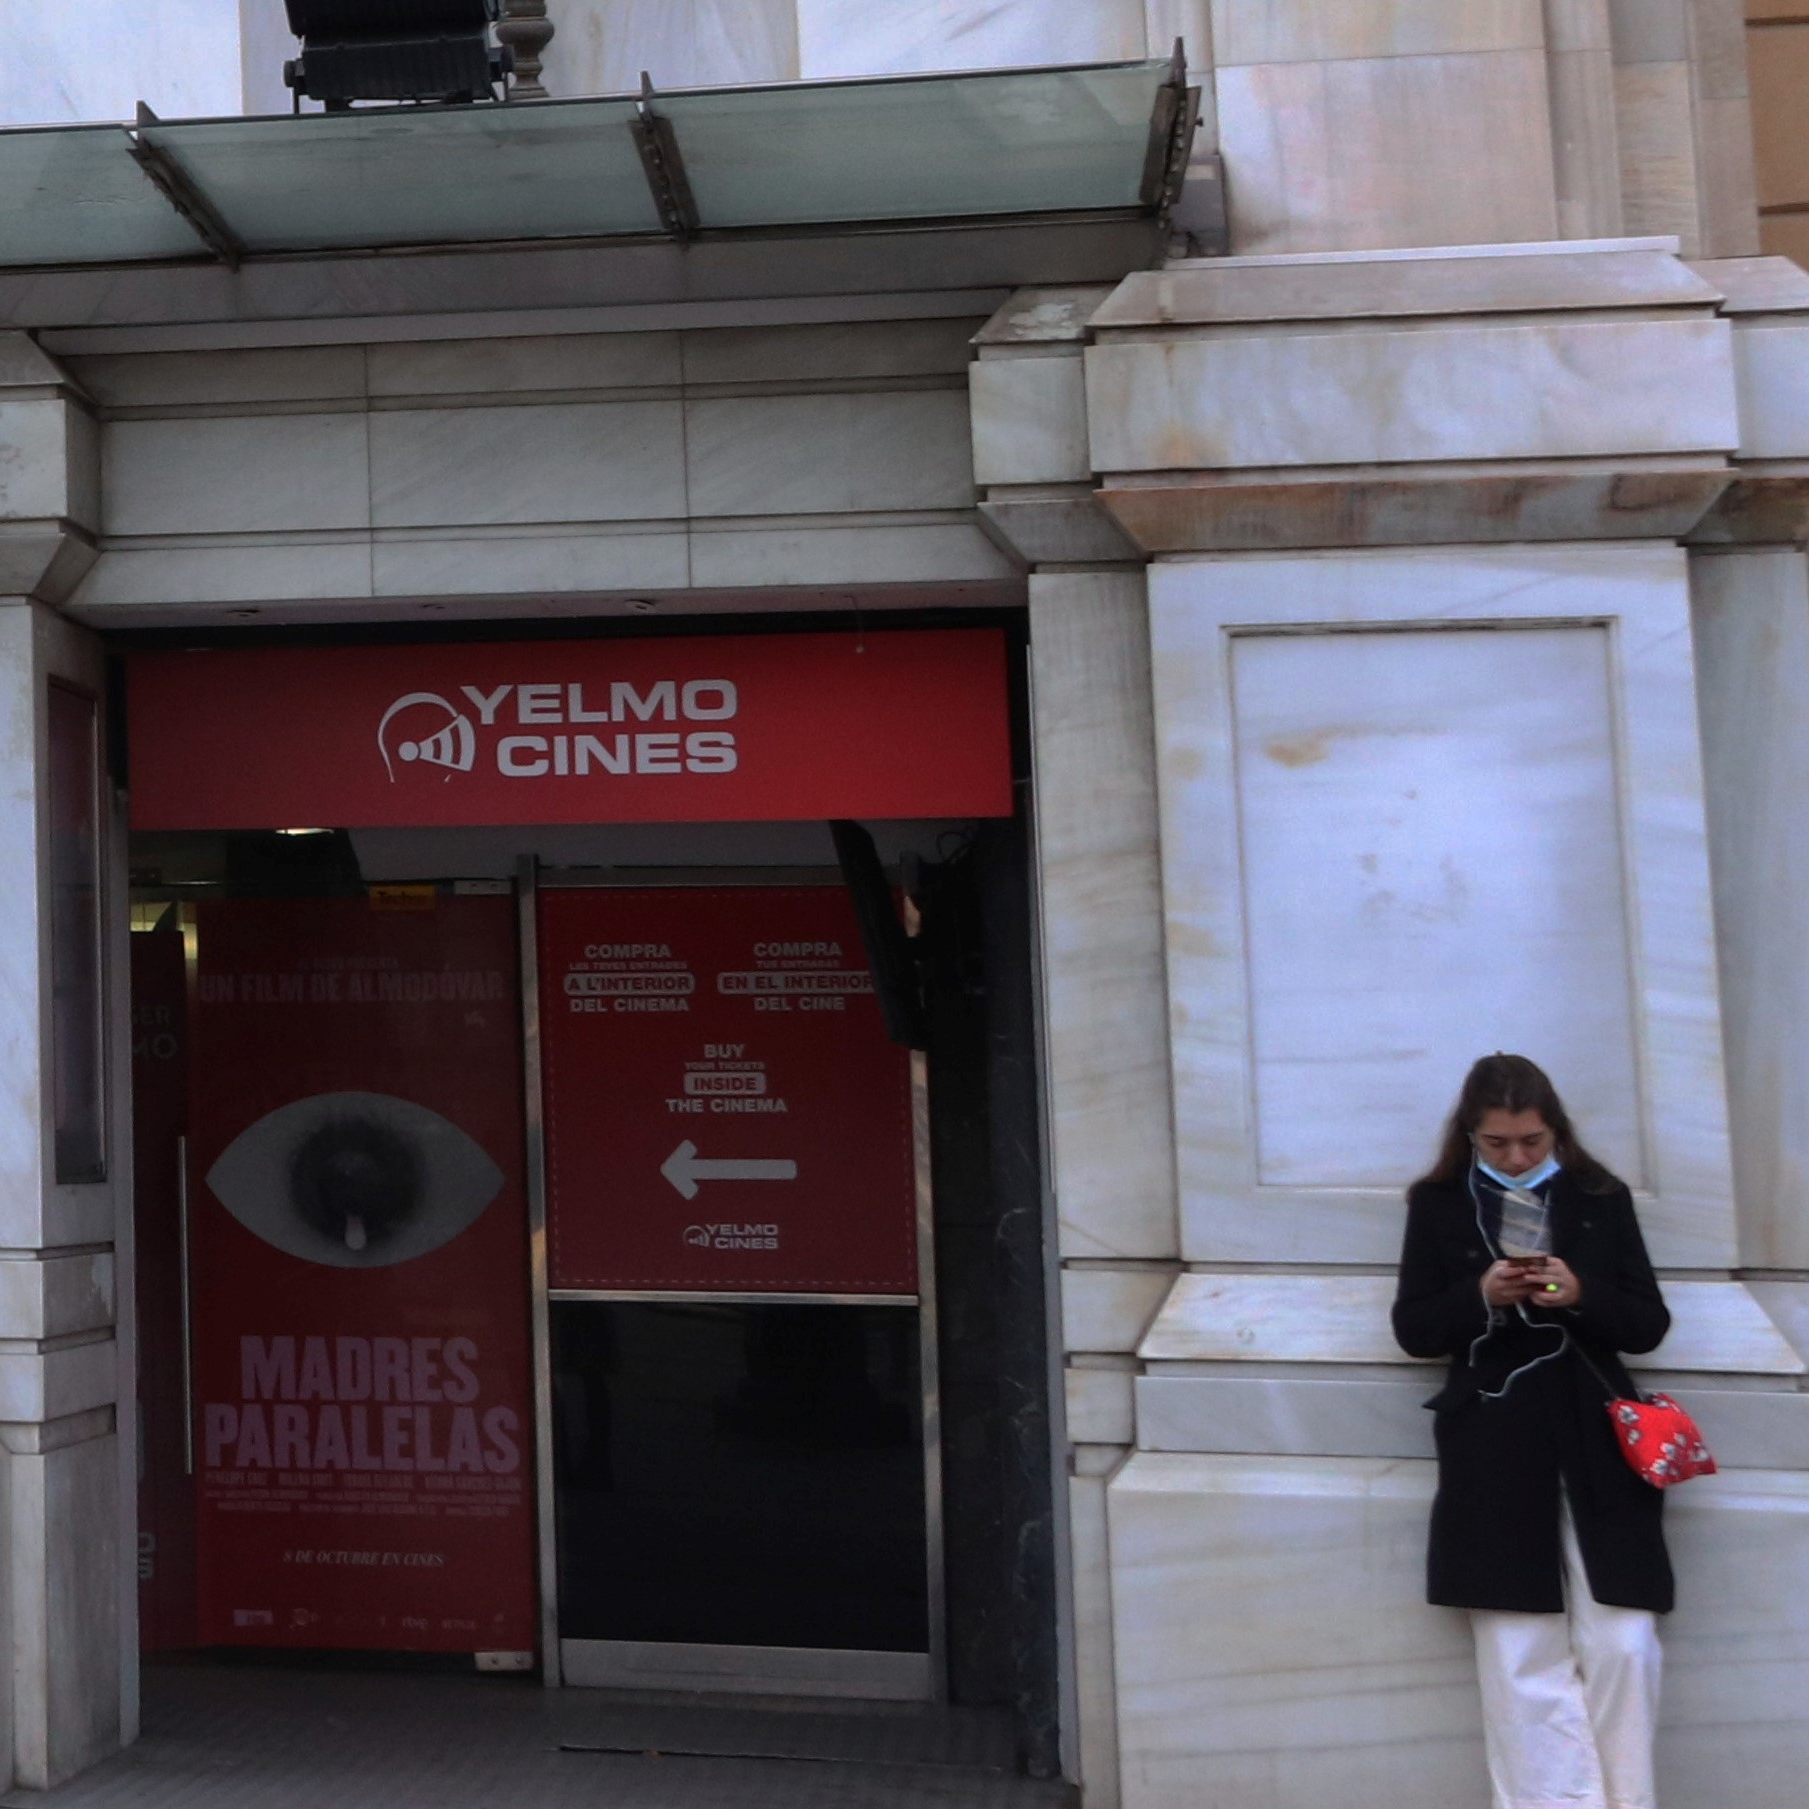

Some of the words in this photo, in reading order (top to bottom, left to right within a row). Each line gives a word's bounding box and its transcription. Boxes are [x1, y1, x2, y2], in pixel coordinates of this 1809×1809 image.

[459, 678, 738, 726] YELMO
[496, 731, 738, 777] CINES
[584, 943, 672, 959] COMPRA
[753, 942, 844, 957] COMPRA
[201, 973, 235, 1003] UN
[241, 973, 305, 1003] FILM
[311, 973, 342, 1002] DE
[347, 964, 504, 1002] ALMODÓVAR
[568, 977, 581, 990] A
[586, 976, 690, 991] L'INTERIOR
[723, 976, 749, 990] EN
[755, 976, 779, 989] EL
[569, 999, 608, 1012] DEL
[613, 998, 691, 1012] CINEMA
[753, 997, 794, 1012] DEL
[798, 996, 847, 1011] CINE
[703, 1043, 747, 1060] BUY
[694, 1077, 758, 1091] INSIDE
[665, 1098, 705, 1113] THE
[709, 1098, 789, 1113] CINEMA
[705, 1223, 779, 1236] YELMO
[714, 1237, 779, 1250] CINES
[239, 1335, 481, 1404] MADRES
[203, 1403, 520, 1474] PARALELAS
[294, 1550, 315, 1563] DE
[316, 1551, 379, 1566] OCTUBRE
[381, 1552, 401, 1566] EN
[403, 1552, 447, 1567] CINES
